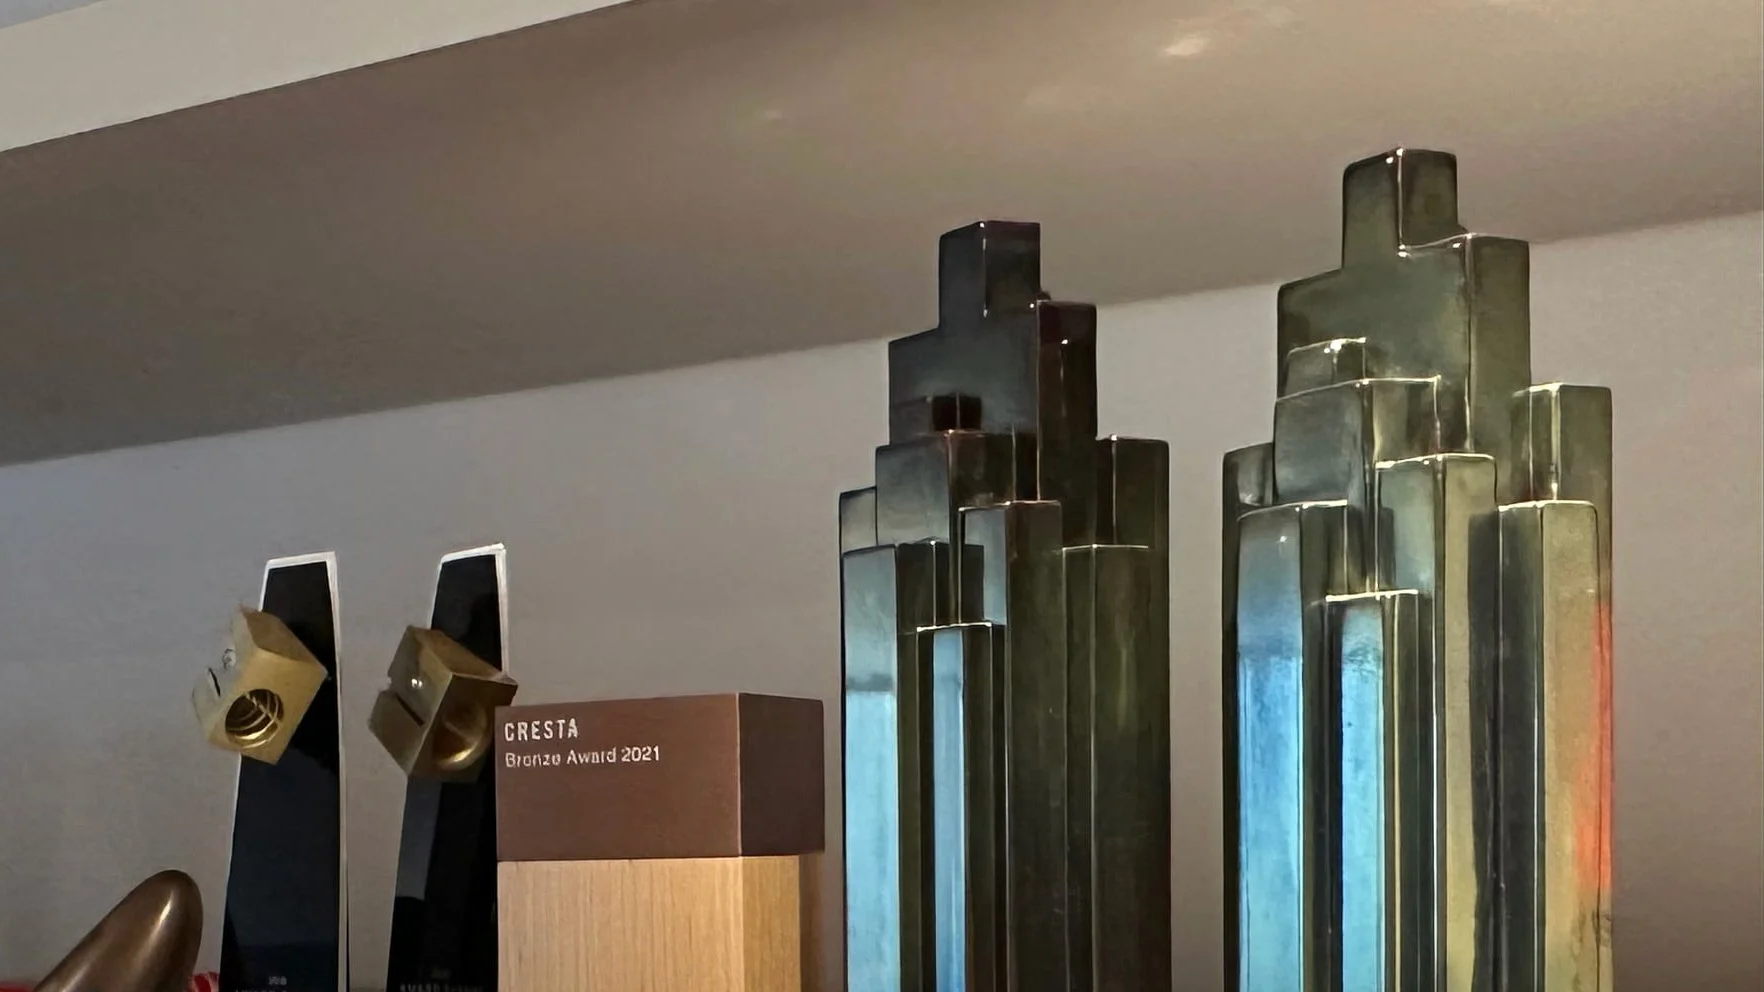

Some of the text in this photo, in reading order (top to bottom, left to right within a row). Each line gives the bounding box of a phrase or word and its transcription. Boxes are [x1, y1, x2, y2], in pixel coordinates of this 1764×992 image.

[504, 717, 579, 742] CRESTA
[505, 745, 660, 767] Bronze Award 2021
